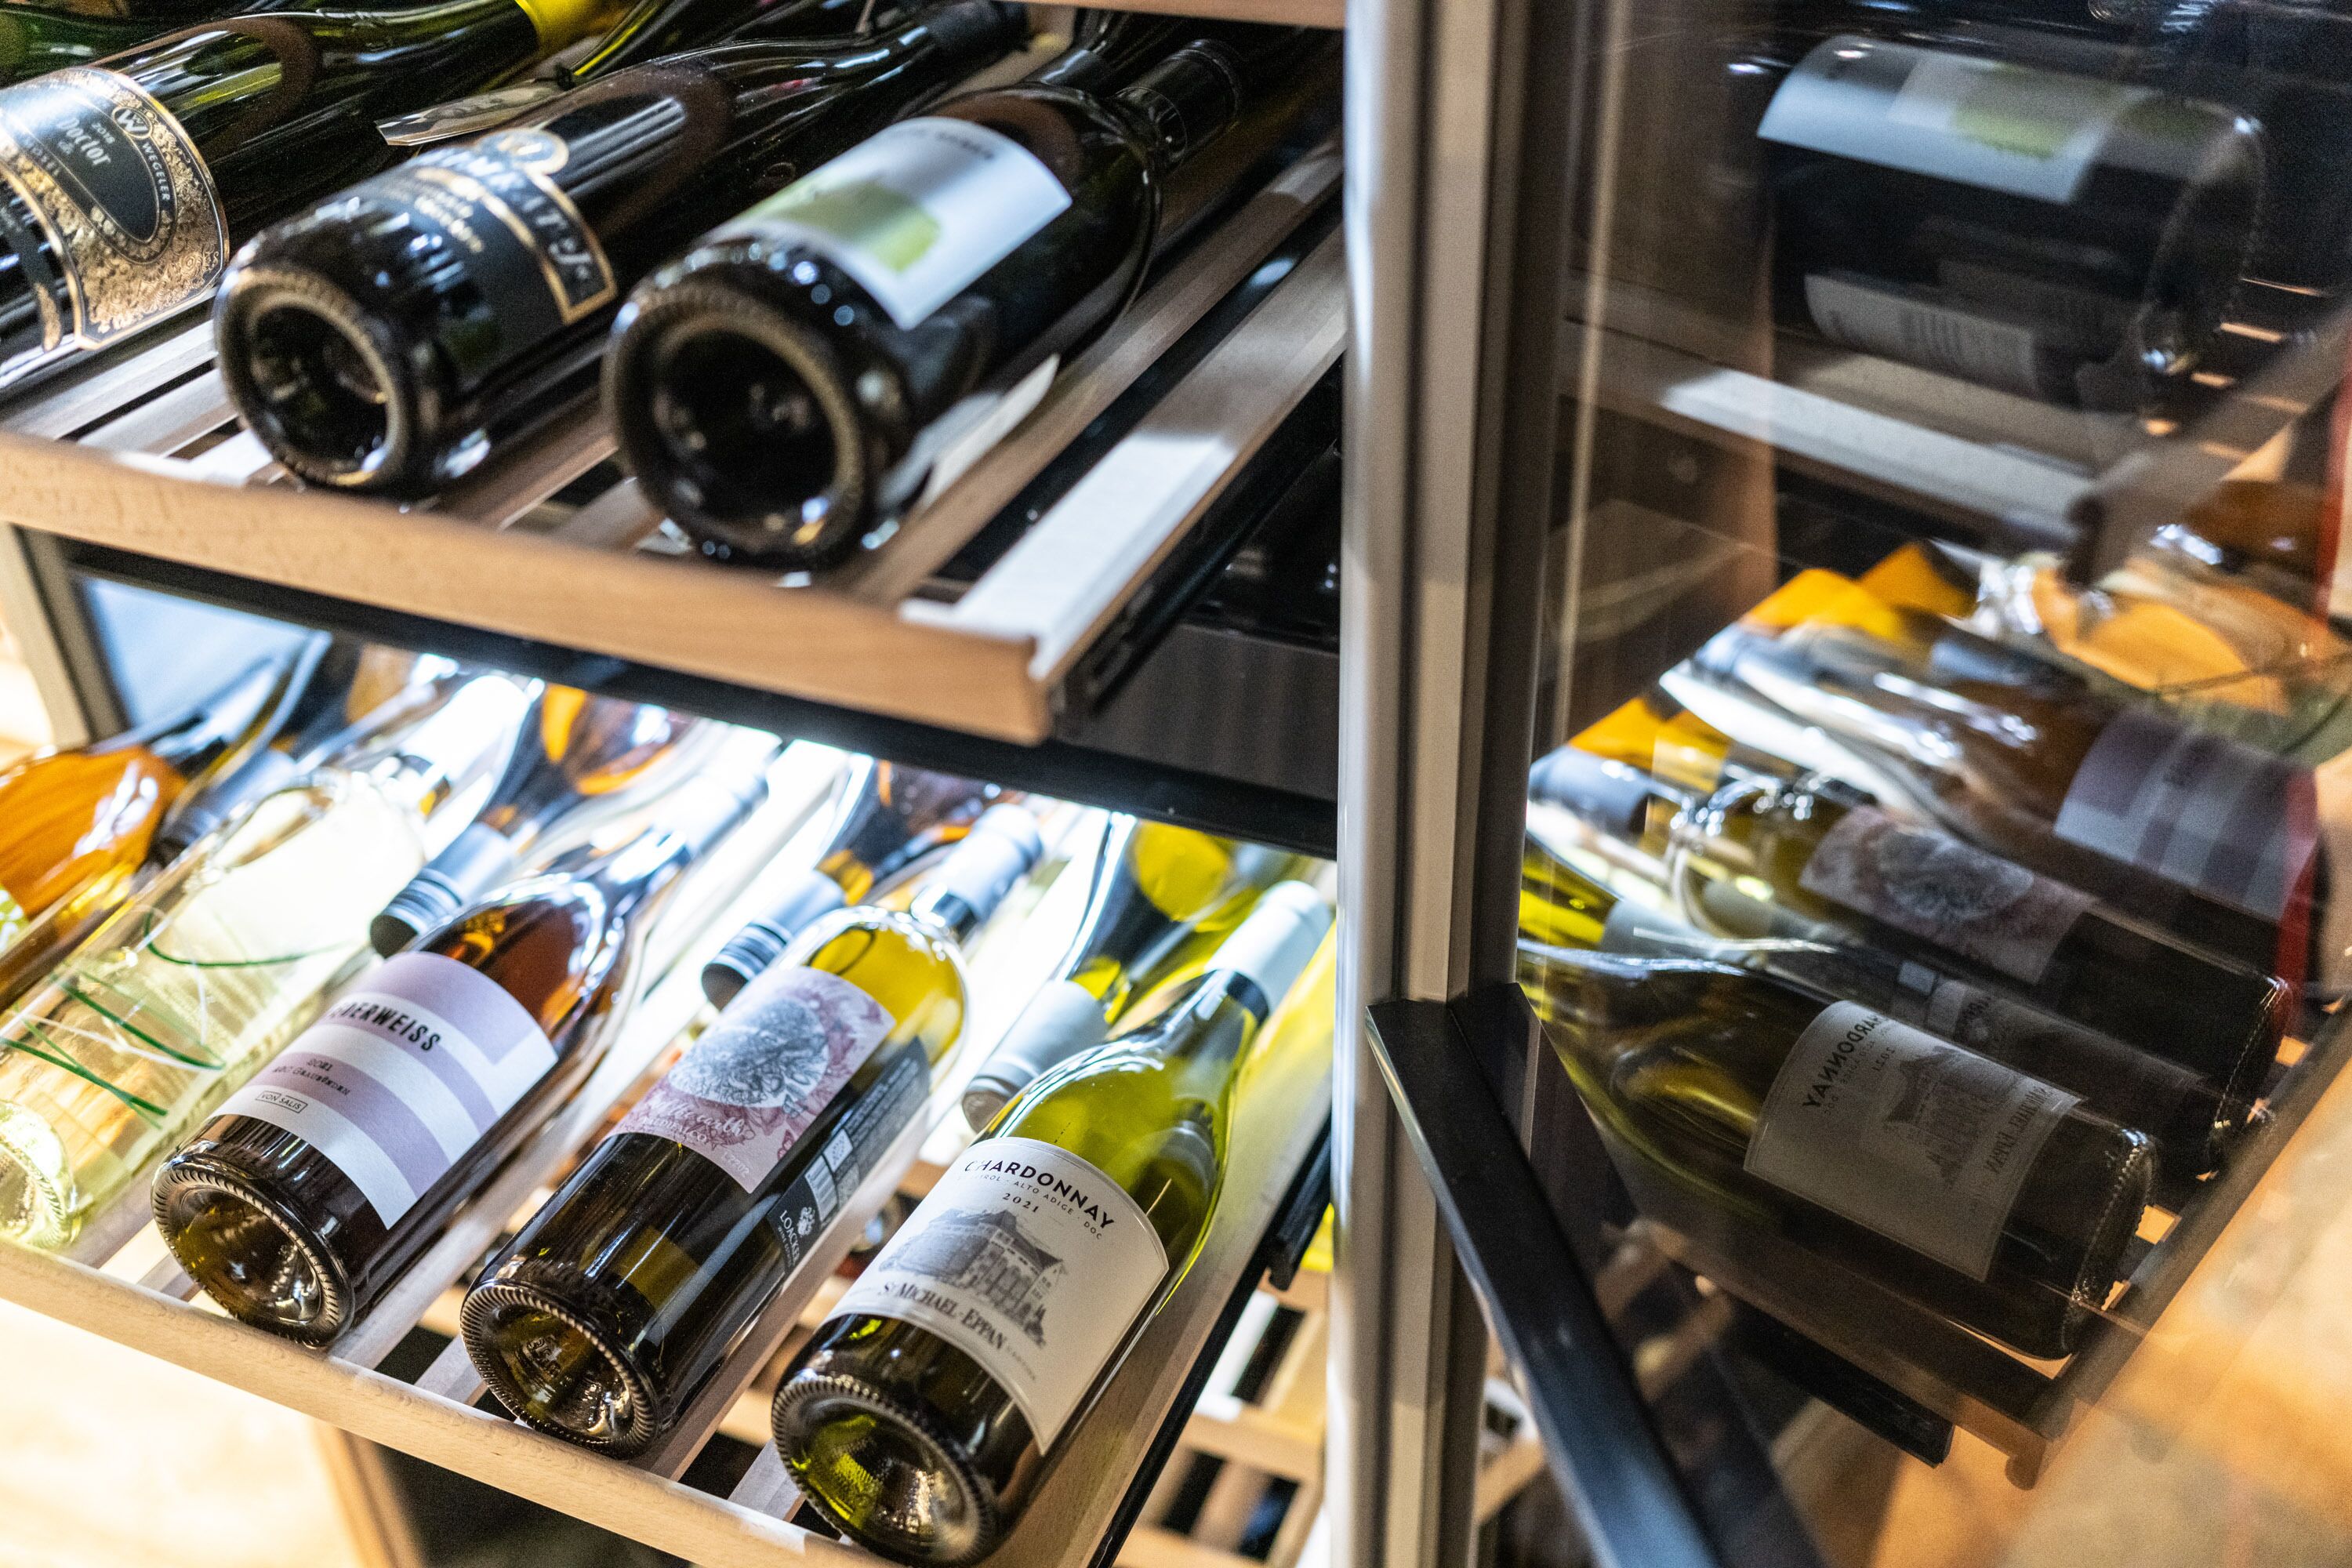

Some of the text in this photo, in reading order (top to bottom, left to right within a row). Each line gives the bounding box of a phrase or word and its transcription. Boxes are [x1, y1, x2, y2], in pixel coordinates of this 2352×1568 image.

[57, 118, 112, 167] Doctor
[142, 142, 171, 201] WEGELER
[278, 1097, 303, 1110] SALIS
[696, 1115, 745, 1136] earth
[964, 1160, 1114, 1229] CHARDONNAY
[1003, 1192, 1040, 1213] 2021
[1014, 1181, 1040, 1194] ALTO
[1044, 1193, 1074, 1215] ADIGE
[1083, 1221, 1102, 1240] DOC
